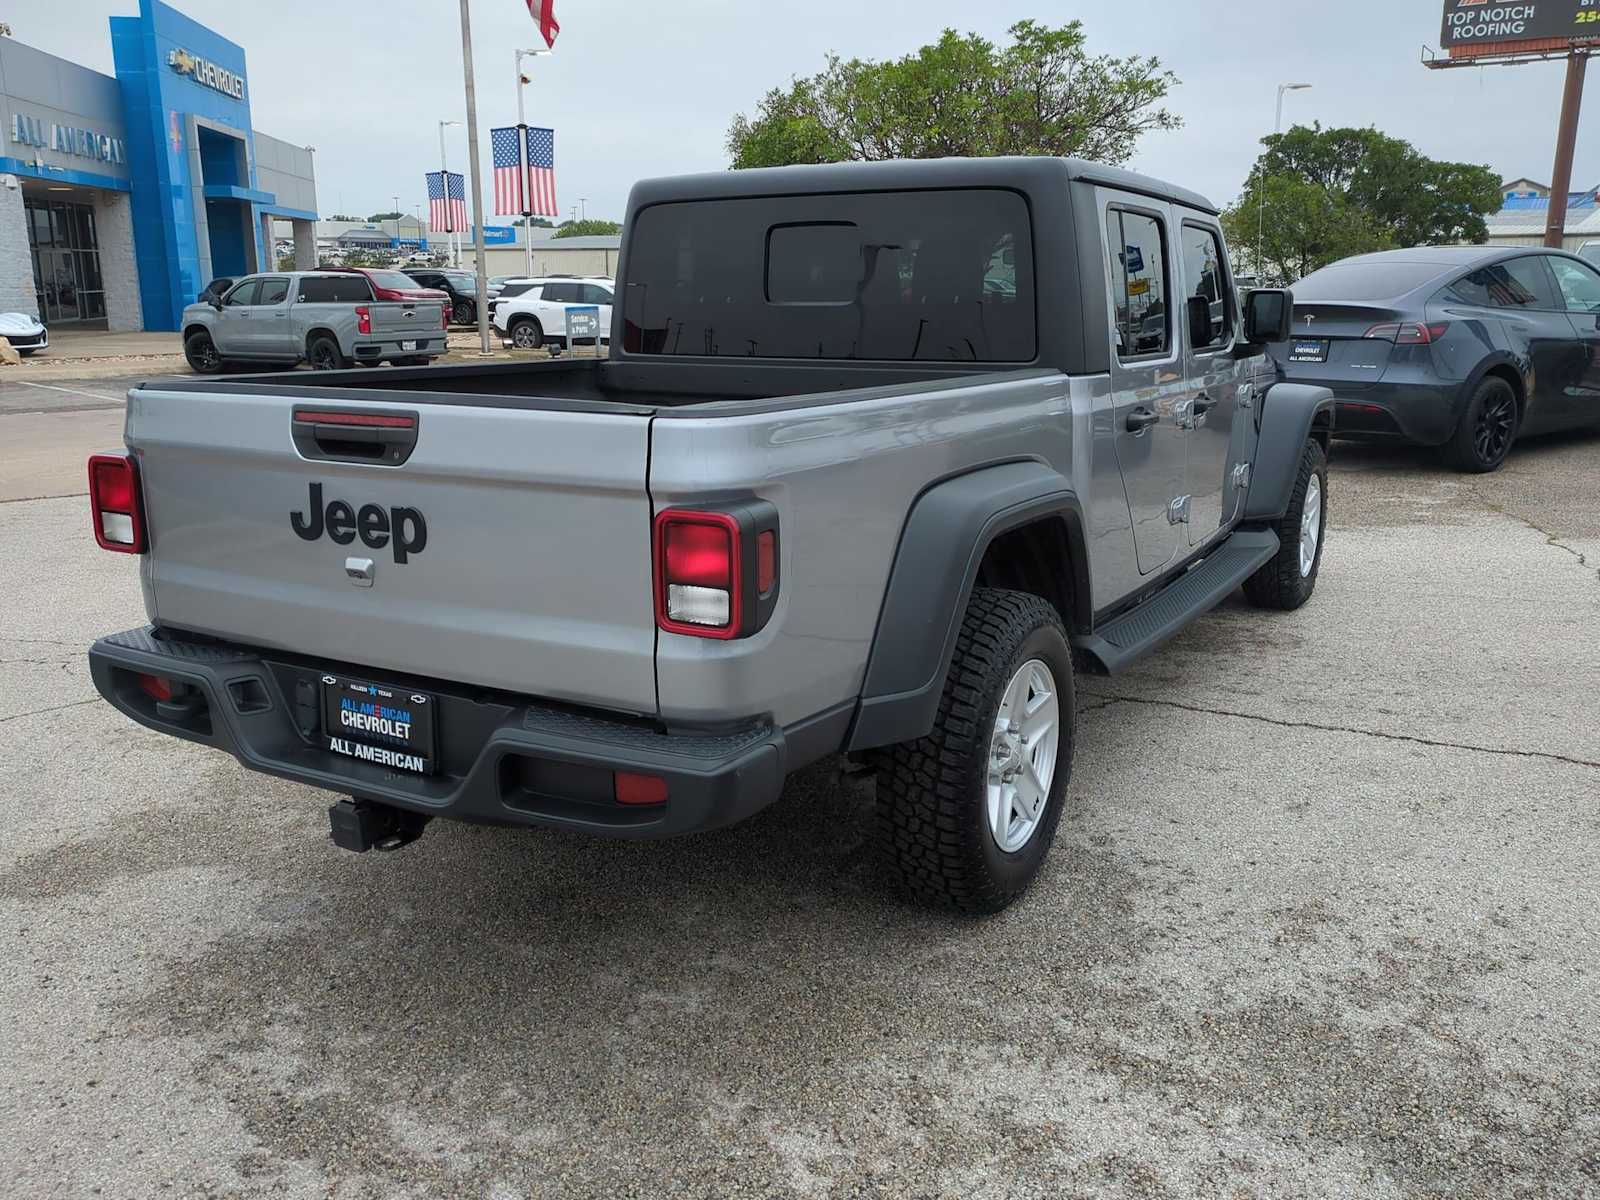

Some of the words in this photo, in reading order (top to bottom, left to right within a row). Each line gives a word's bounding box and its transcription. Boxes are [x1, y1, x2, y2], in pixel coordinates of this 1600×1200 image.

[1447, 12, 1475, 26] TOP
[1479, 6, 1535, 22] NOTCH
[1452, 21, 1525, 39] ROOFING
[1575, 11, 1600, 23] 25
[195, 56, 245, 99] CHEVROLET
[12, 112, 48, 148] ALL
[51, 123, 126, 164] AMERICAN
[290, 482, 427, 564] Jeep
[340, 710, 411, 739] CHEVROLET
[341, 698, 358, 712] ALL
[360, 702, 411, 722] AMERICAN
[330, 738, 352, 756] ALL
[354, 744, 424, 772] AMERICAN
